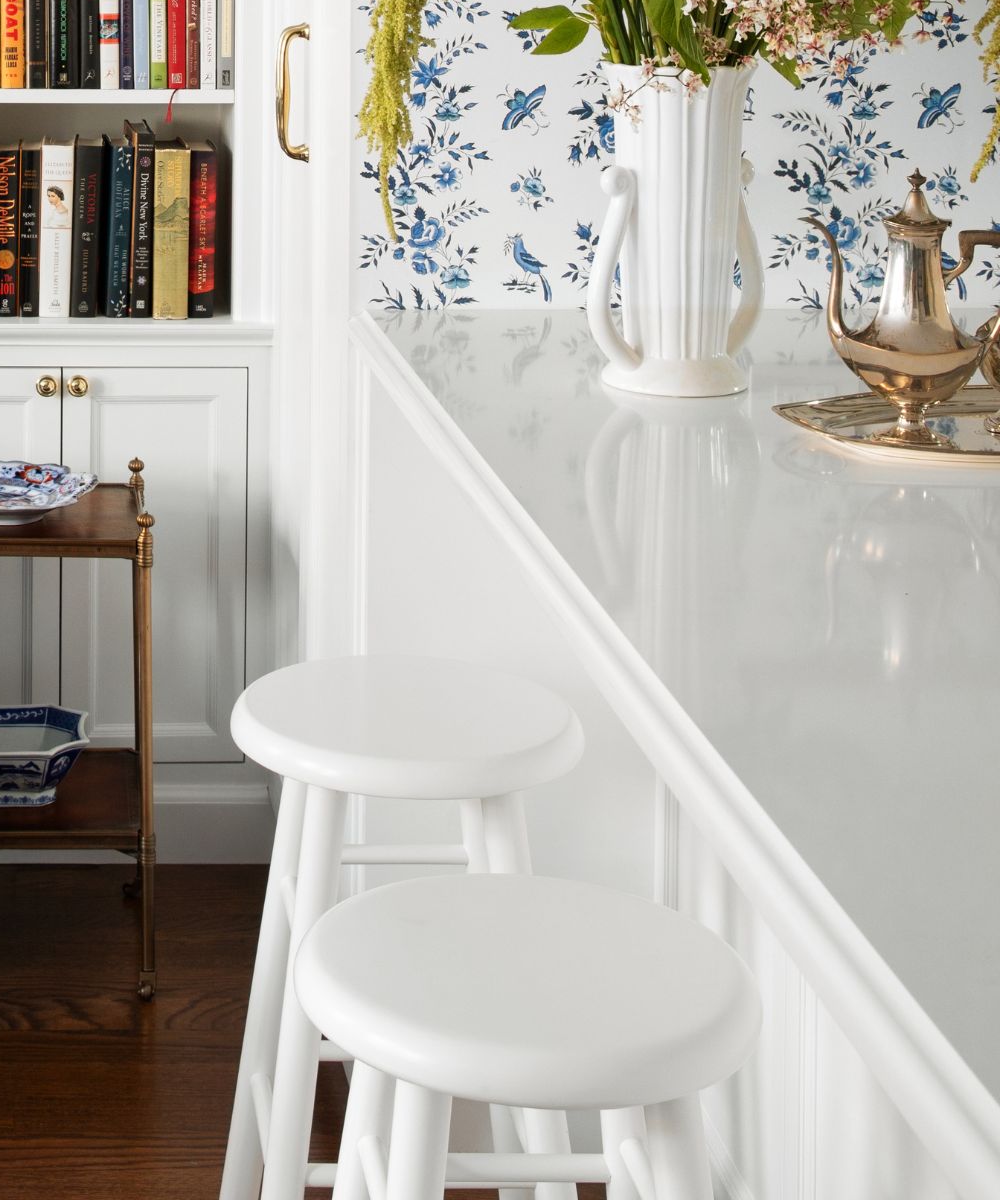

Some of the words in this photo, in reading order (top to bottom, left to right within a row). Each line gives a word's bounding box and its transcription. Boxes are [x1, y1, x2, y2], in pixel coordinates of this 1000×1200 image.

[140, 173, 149, 200] Divine
[200, 162, 208, 195] BENEATH
[86, 174, 97, 225] VICTORIA
[115, 181, 123, 218] HOFFMAN
[122, 188, 130, 211] ALICE
[139, 202, 149, 221] New
[138, 222, 148, 241] York
[199, 205, 207, 235] SCARLET
